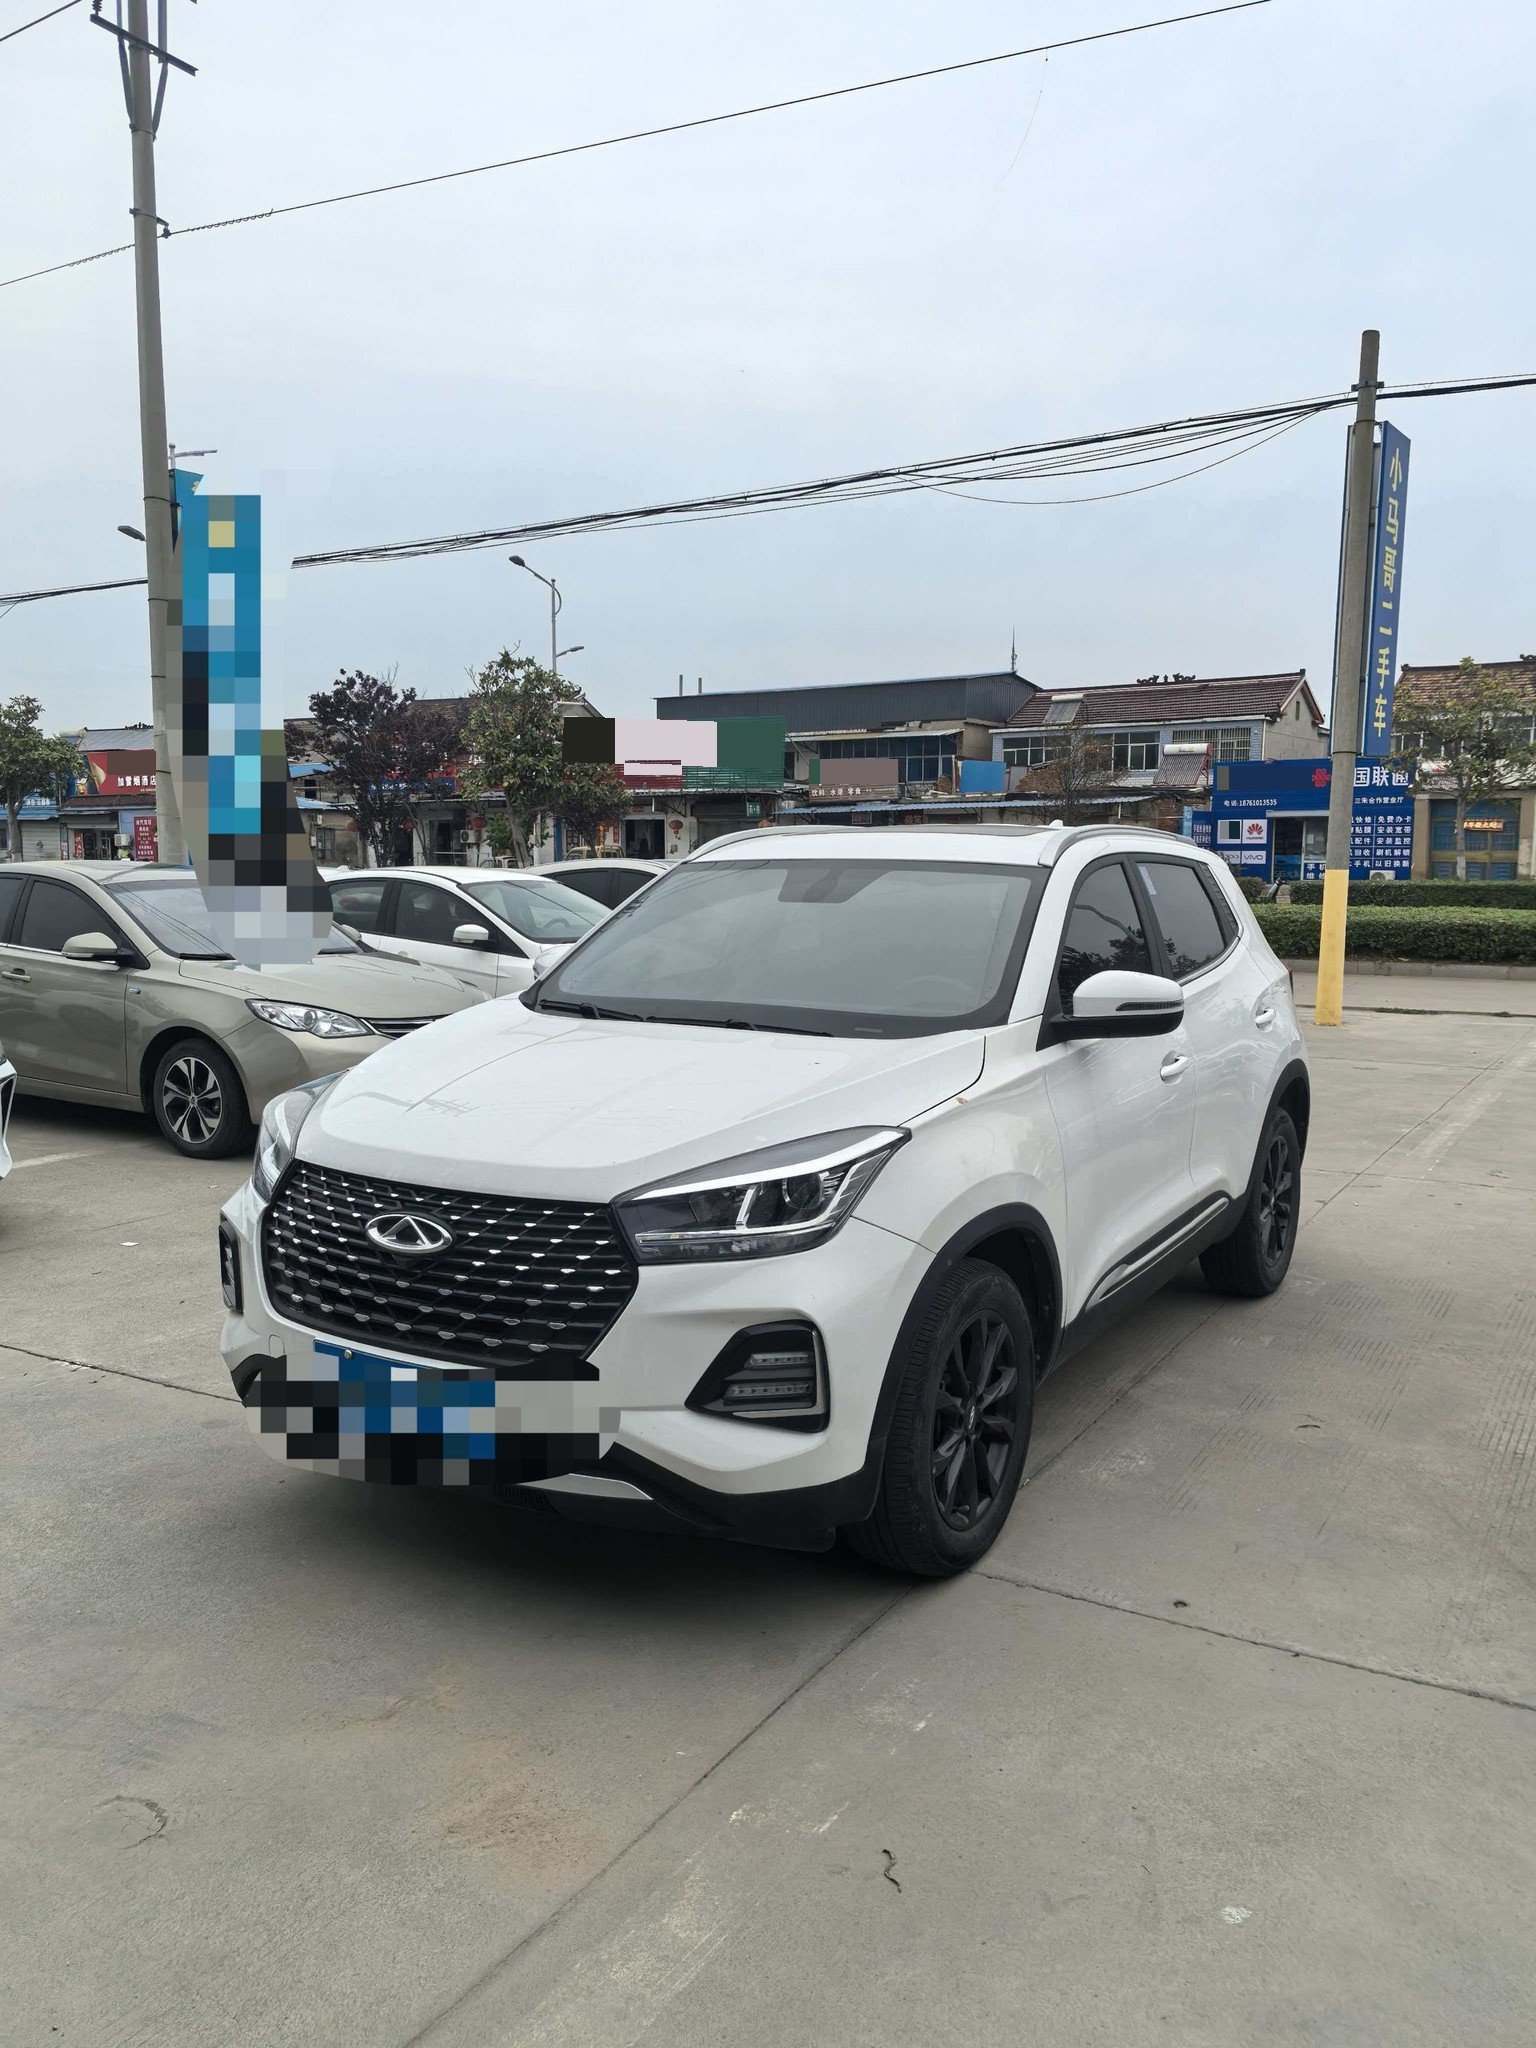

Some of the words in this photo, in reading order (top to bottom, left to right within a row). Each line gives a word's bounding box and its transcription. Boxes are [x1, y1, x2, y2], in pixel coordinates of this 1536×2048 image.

[1377, 816, 1412, 824] 免费办卡
[1376, 826, 1412, 834] 安装宽带
[1376, 837, 1411, 845] 安装监控
[1375, 848, 1411, 857] 刷机解锁
[1375, 860, 1410, 868] 以旧换新
